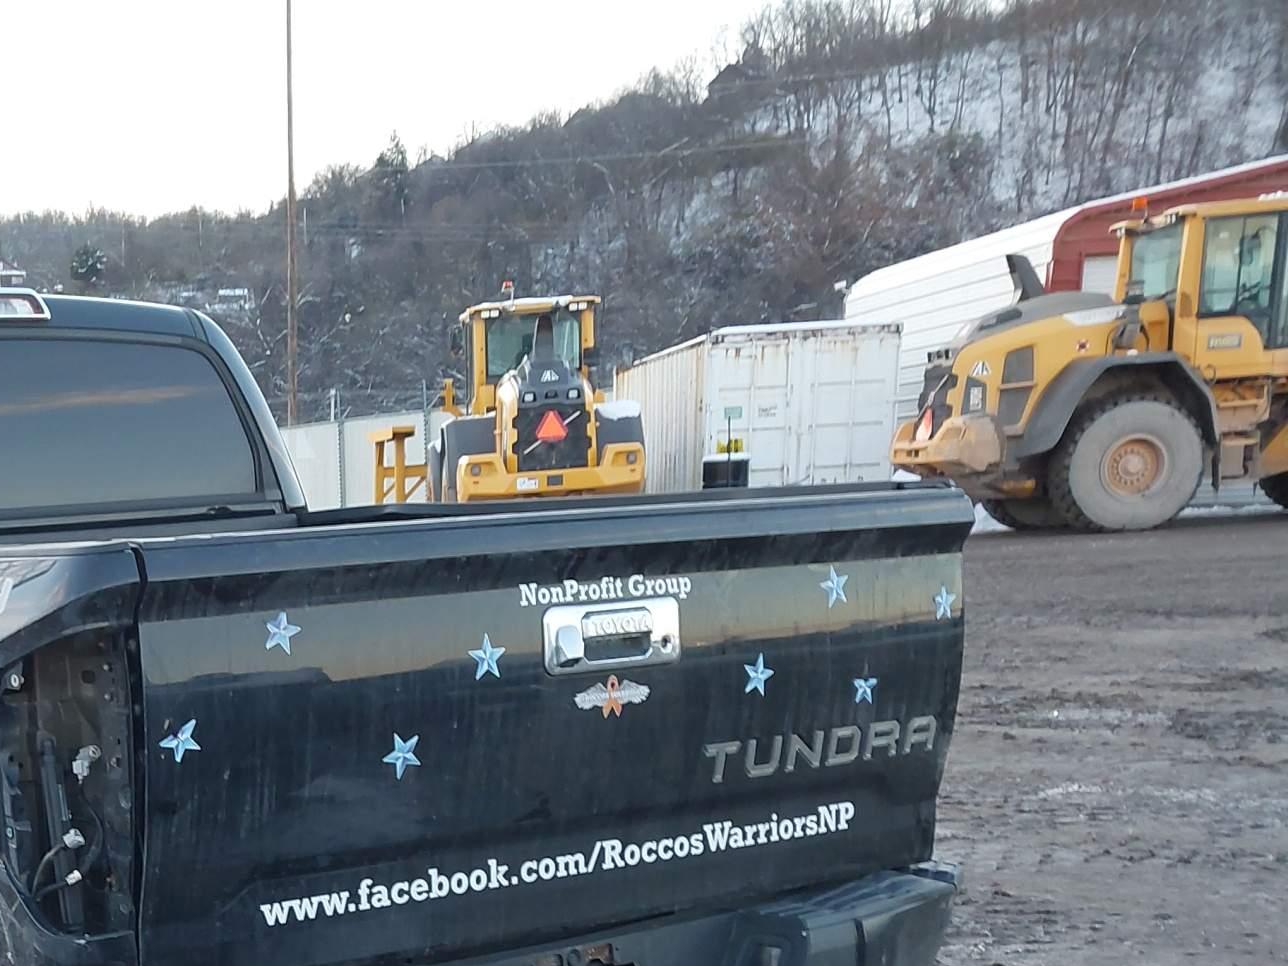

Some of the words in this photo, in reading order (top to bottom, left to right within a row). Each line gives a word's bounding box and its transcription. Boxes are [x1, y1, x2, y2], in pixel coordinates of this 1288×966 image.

[519, 576, 624, 606] NonProfit
[628, 574, 692, 599] Group
[592, 614, 651, 637] TOYOTA
[704, 715, 936, 784] TUNDRA
[260, 801, 855, 926] www.facebook.com/RoccosWarriorsNP
